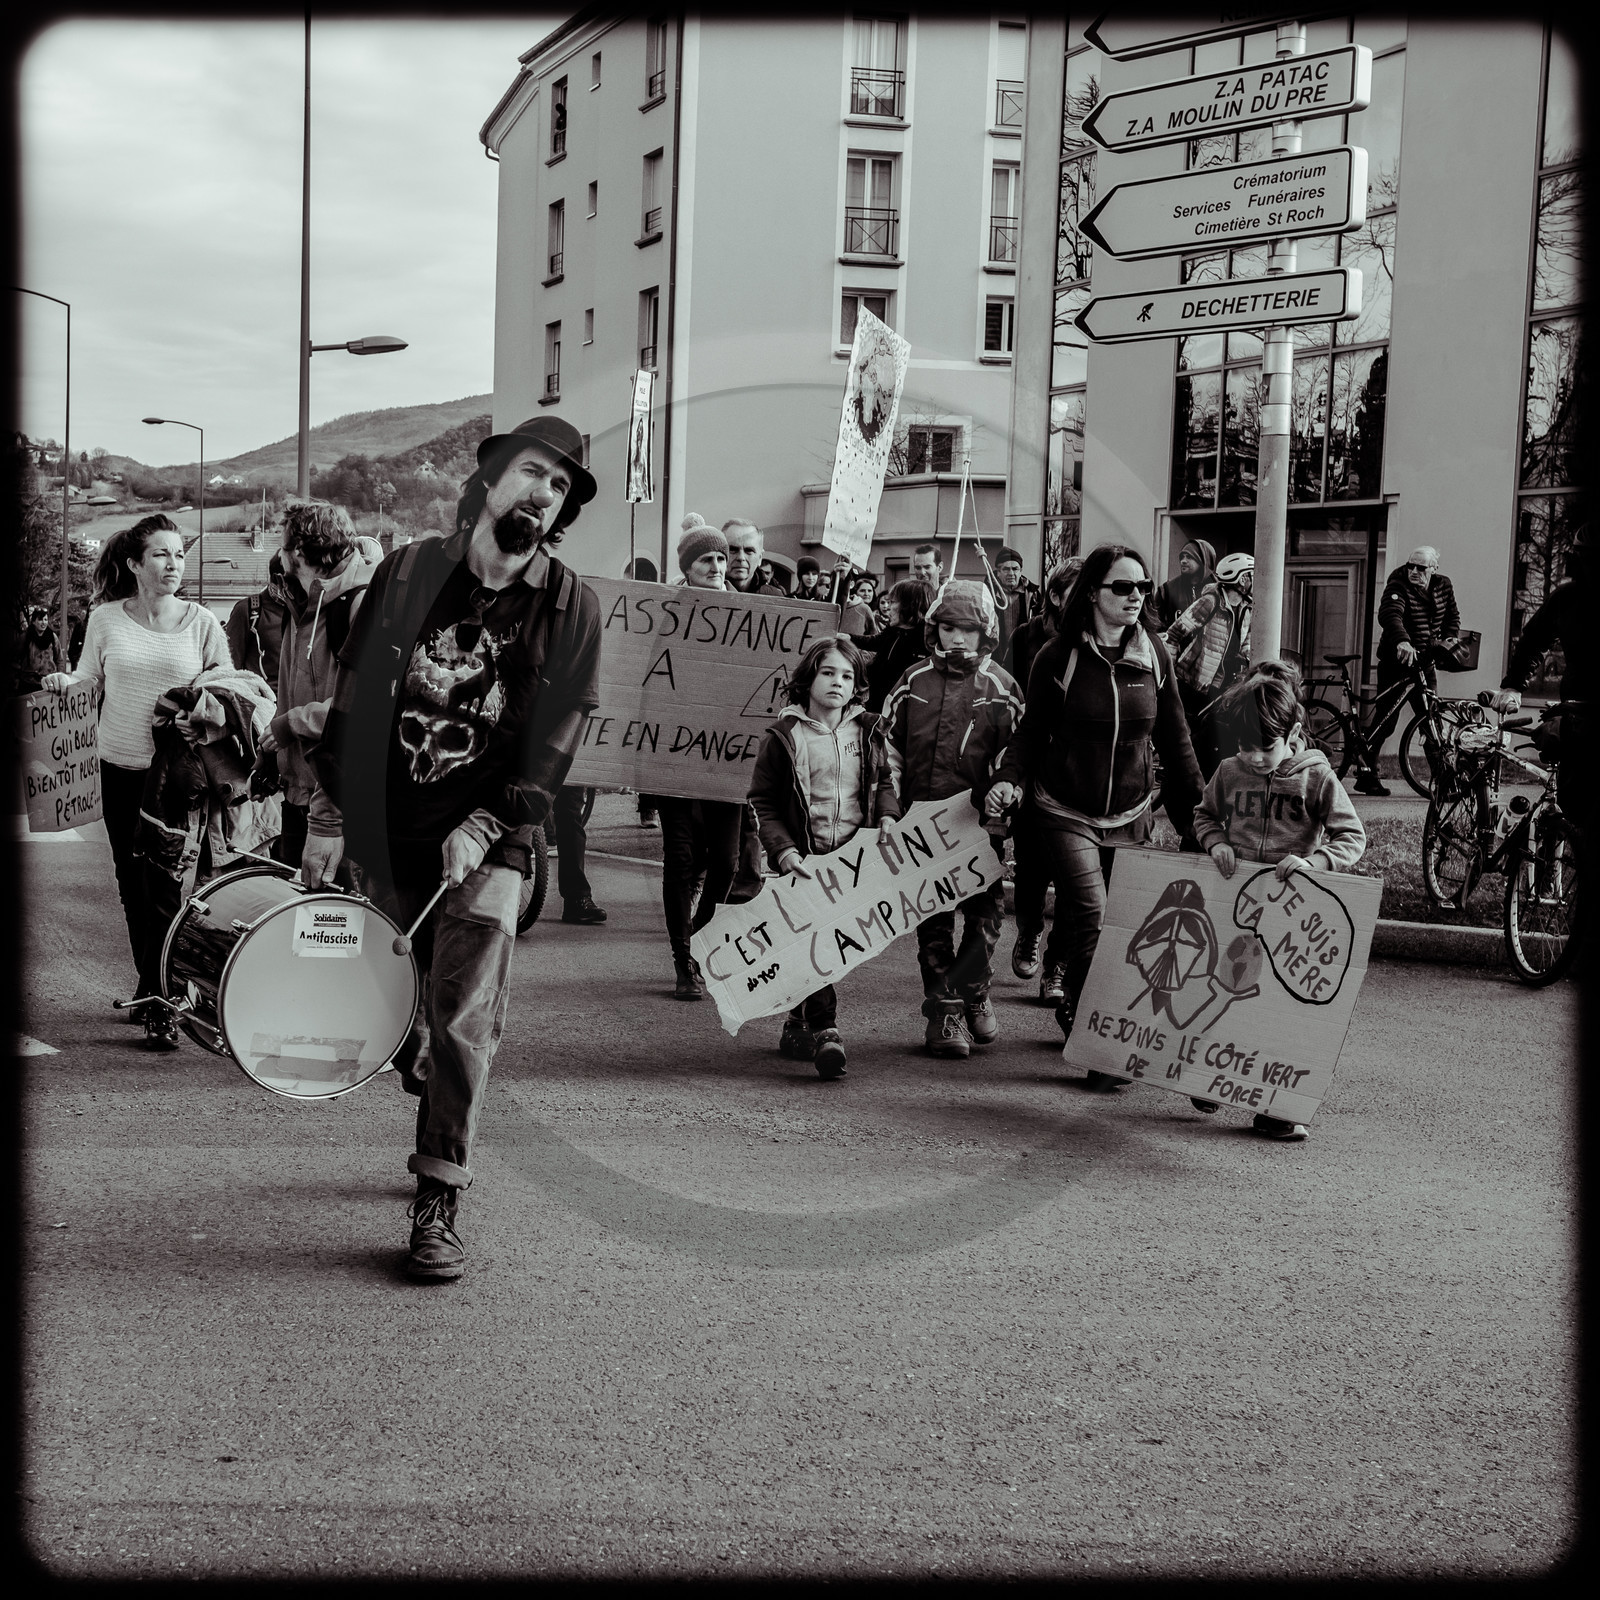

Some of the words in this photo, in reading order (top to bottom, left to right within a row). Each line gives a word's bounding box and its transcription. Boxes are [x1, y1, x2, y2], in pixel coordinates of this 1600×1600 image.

[1214, 78, 1245, 99] Z.A
[1259, 61, 1330, 91] PATAC
[1125, 117, 1155, 138] Z.A
[1167, 99, 1244, 130] MOULIN
[1250, 92, 1279, 114] DU
[1284, 83, 1329, 109] PRE
[1232, 164, 1327, 190] Crématorium
[1172, 200, 1232, 219] Services
[1247, 186, 1326, 208] Funéraires
[1194, 216, 1261, 237] Cimetière
[1267, 211, 1283, 227] St
[1286, 205, 1325, 224] Roch
[1180, 287, 1321, 320] DECHETTERIE
[641, 648, 676, 691] A
[582, 716, 616, 747] TE
[621, 720, 660, 753] EN
[669, 724, 761, 763] DANGE
[79, 755, 95, 782] PLUS
[809, 855, 986, 977] CAMPAGNES
[1239, 890, 1265, 931] TA
[1267, 877, 1306, 917] JE
[313, 913, 347, 923] Solidaires
[299, 930, 358, 945] Antifasciste
[705, 921, 773, 981] C'EST
[1125, 1053, 1149, 1080] DE
[1165, 1062, 1183, 1082] LA
[1177, 1034, 1198, 1065] LE
[1204, 1042, 1261, 1076] CÔTÉ
[1262, 1059, 1311, 1090] VERT
